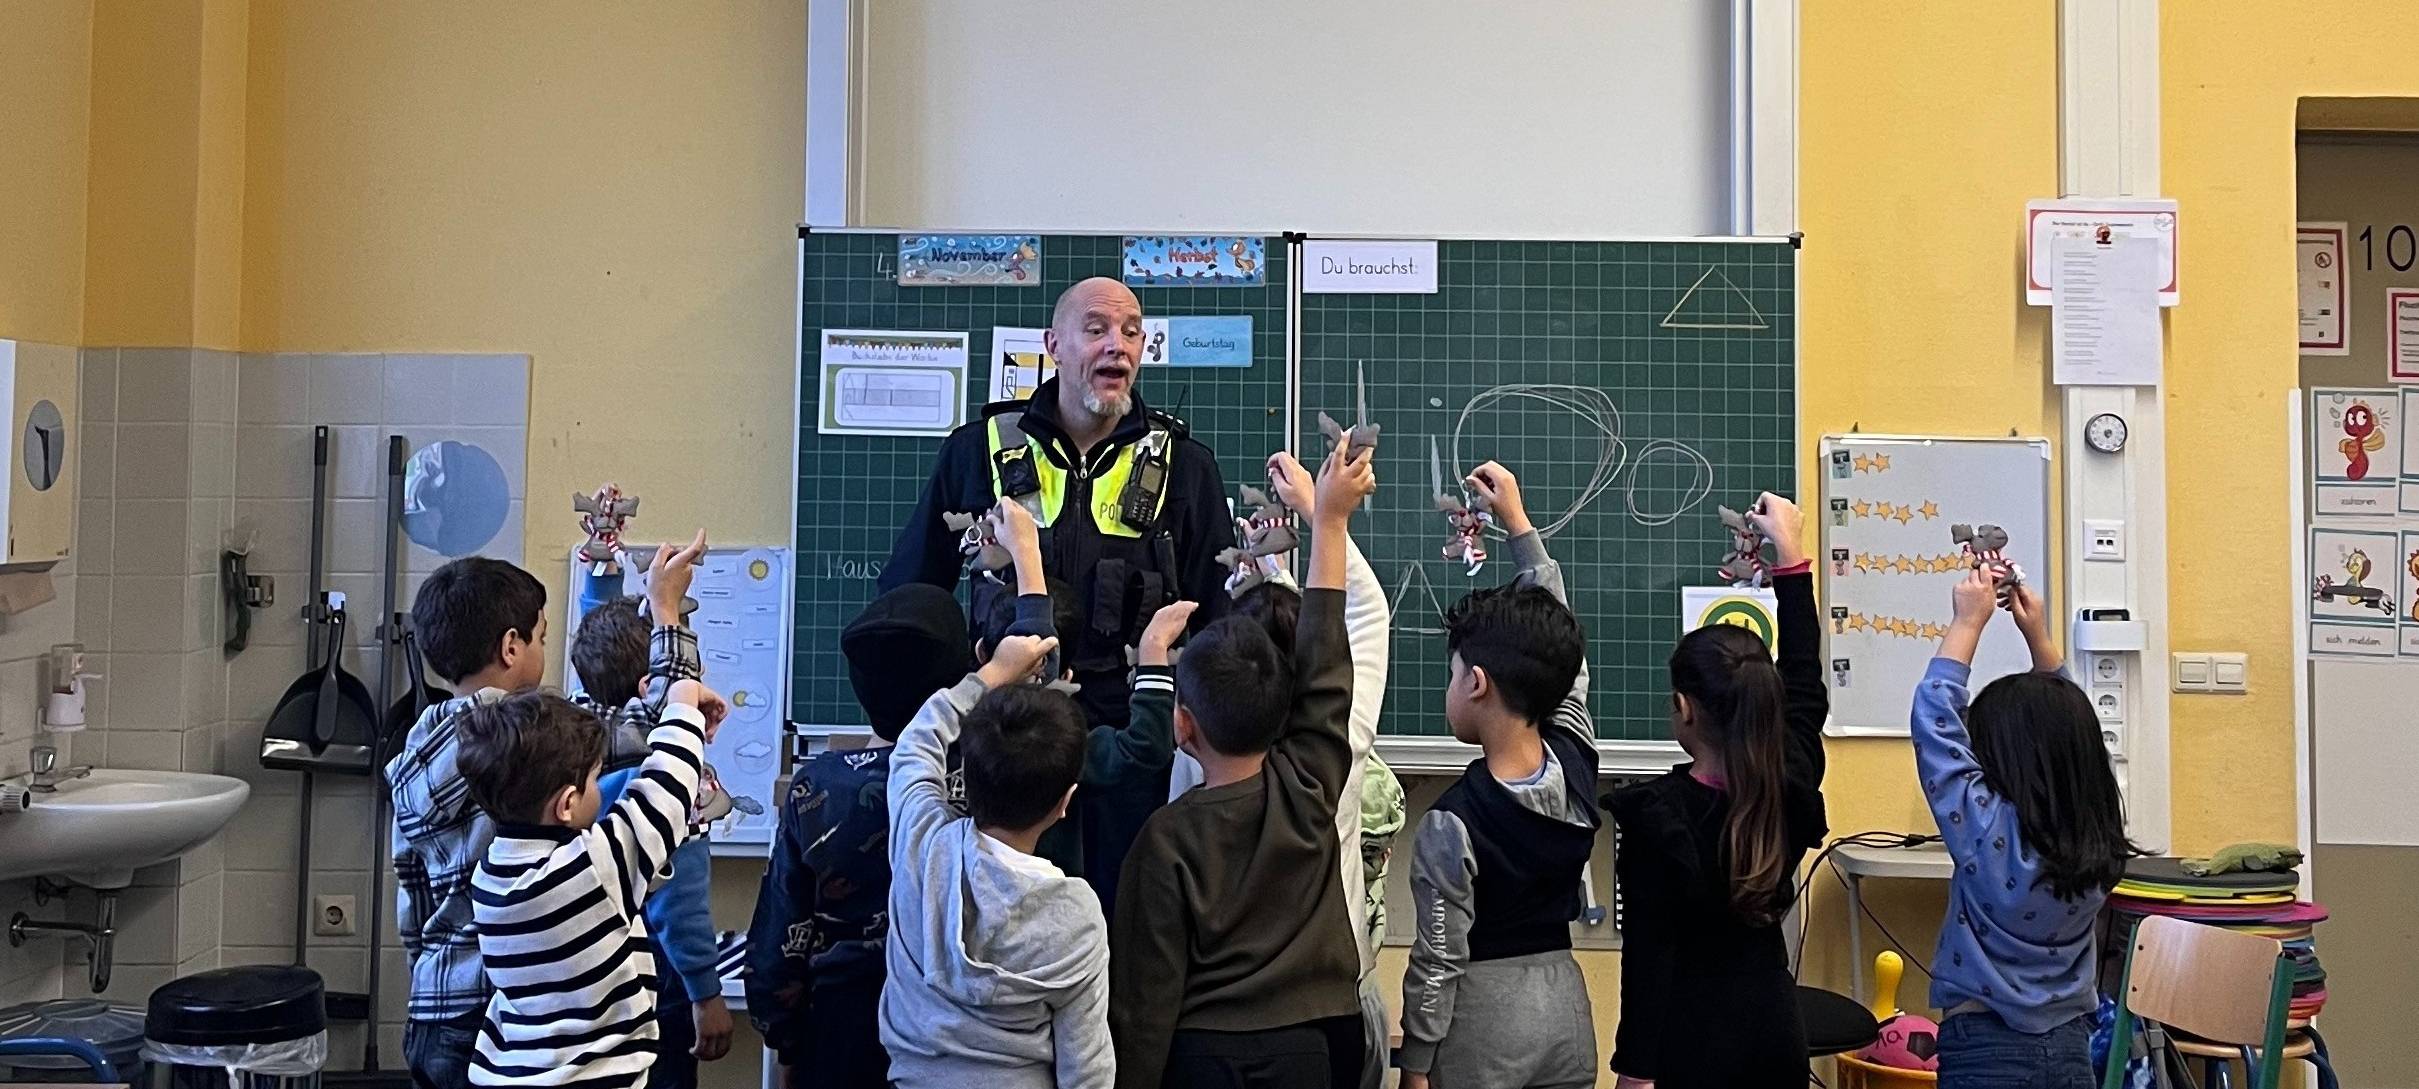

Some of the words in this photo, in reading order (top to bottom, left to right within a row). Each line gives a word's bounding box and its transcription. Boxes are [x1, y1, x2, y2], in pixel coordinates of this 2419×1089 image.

[930, 247, 1007, 263] November
[1168, 246, 1218, 263] Herbst
[2359, 224, 2417, 272] 10
[1321, 256, 1343, 274] Du
[1348, 256, 1419, 274] brauchst:
[1182, 337, 1235, 351] Geburtstag
